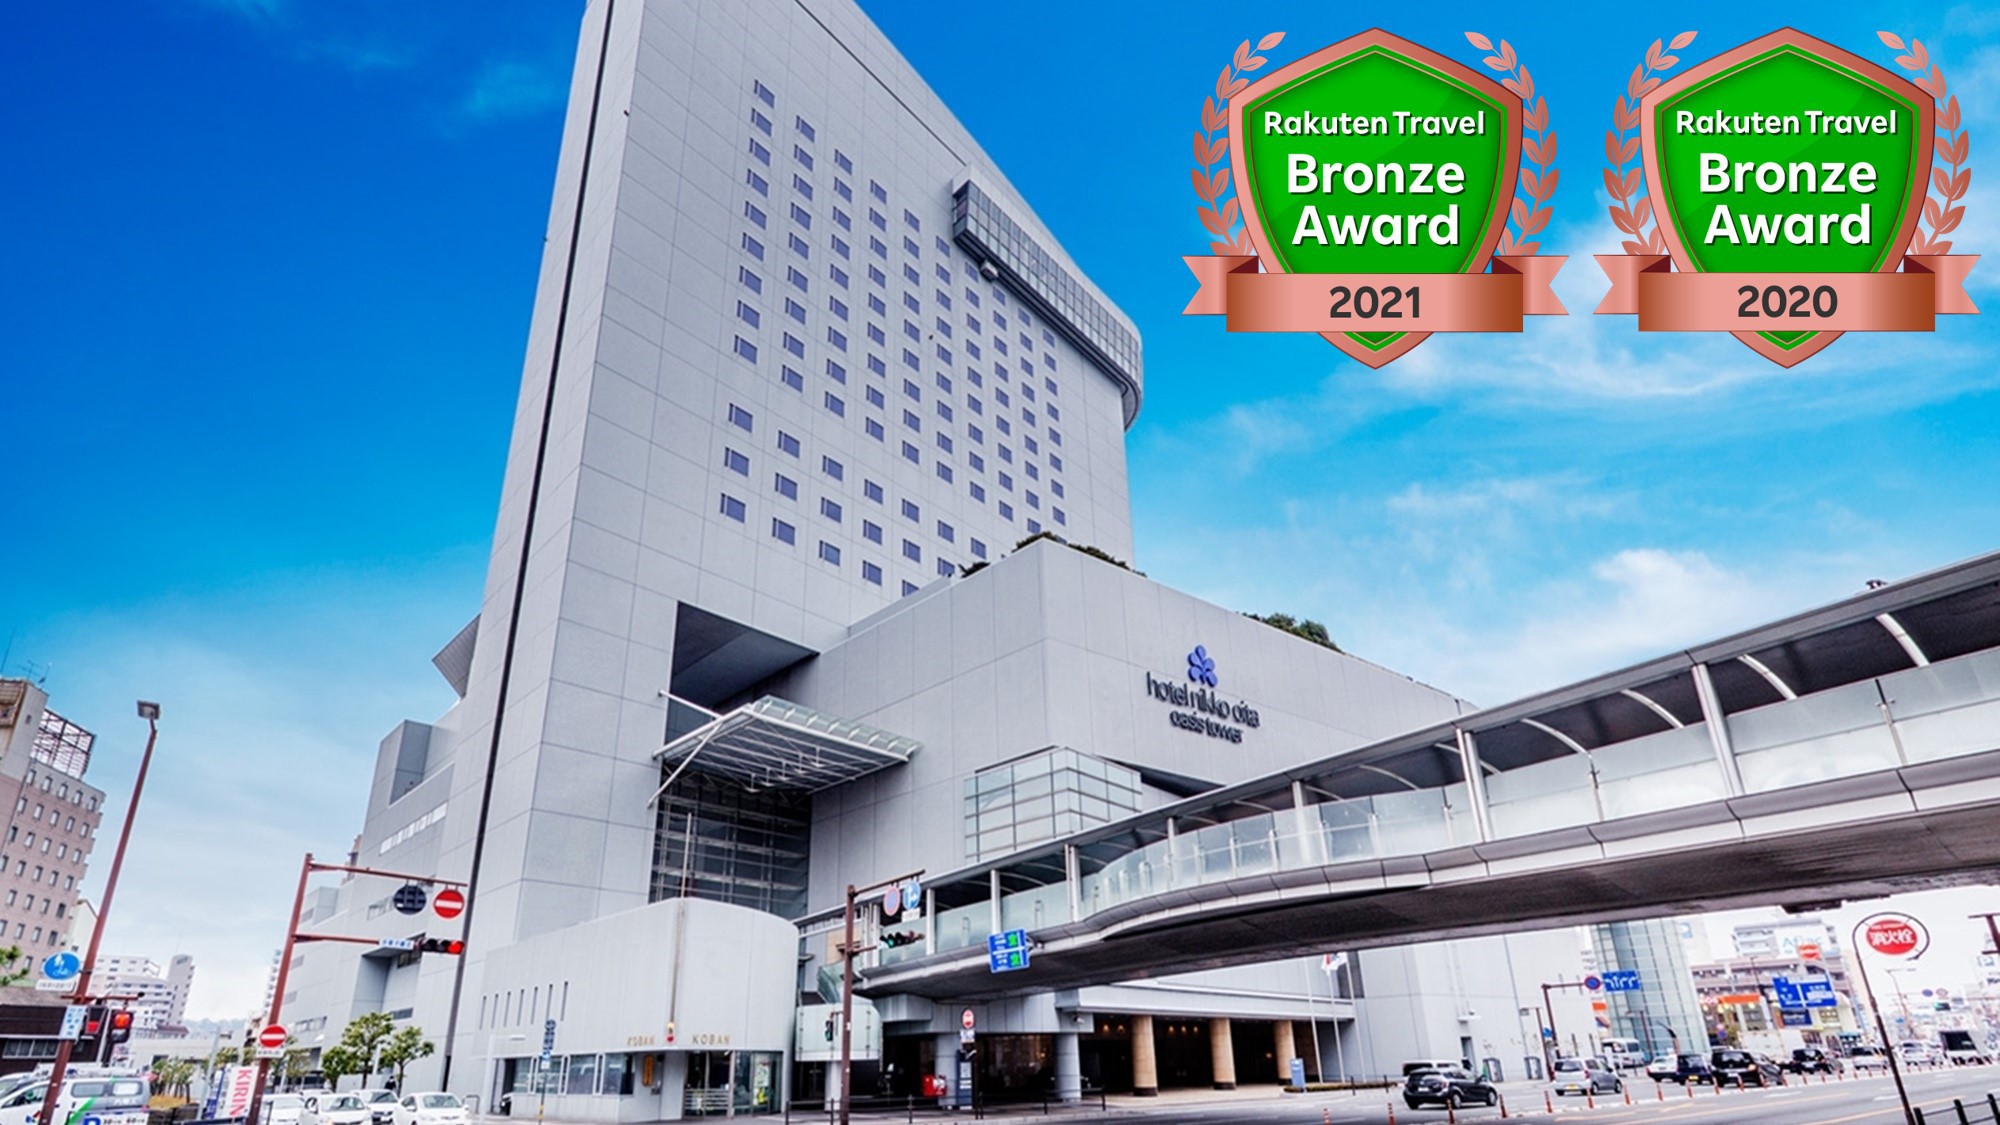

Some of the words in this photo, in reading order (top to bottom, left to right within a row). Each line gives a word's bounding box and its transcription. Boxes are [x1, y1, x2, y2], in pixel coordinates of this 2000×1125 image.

[1146, 671, 1188, 706] hotel
[1190, 688, 1230, 719] nikko
[1232, 700, 1260, 728] oita
[1169, 710, 1205, 734] oasis
[1205, 717, 1243, 744] tower
[1869, 928, 1915, 946] 消火栓
[692, 1034, 731, 1045] KOBAN
[229, 1069, 253, 1117] KIRIN
